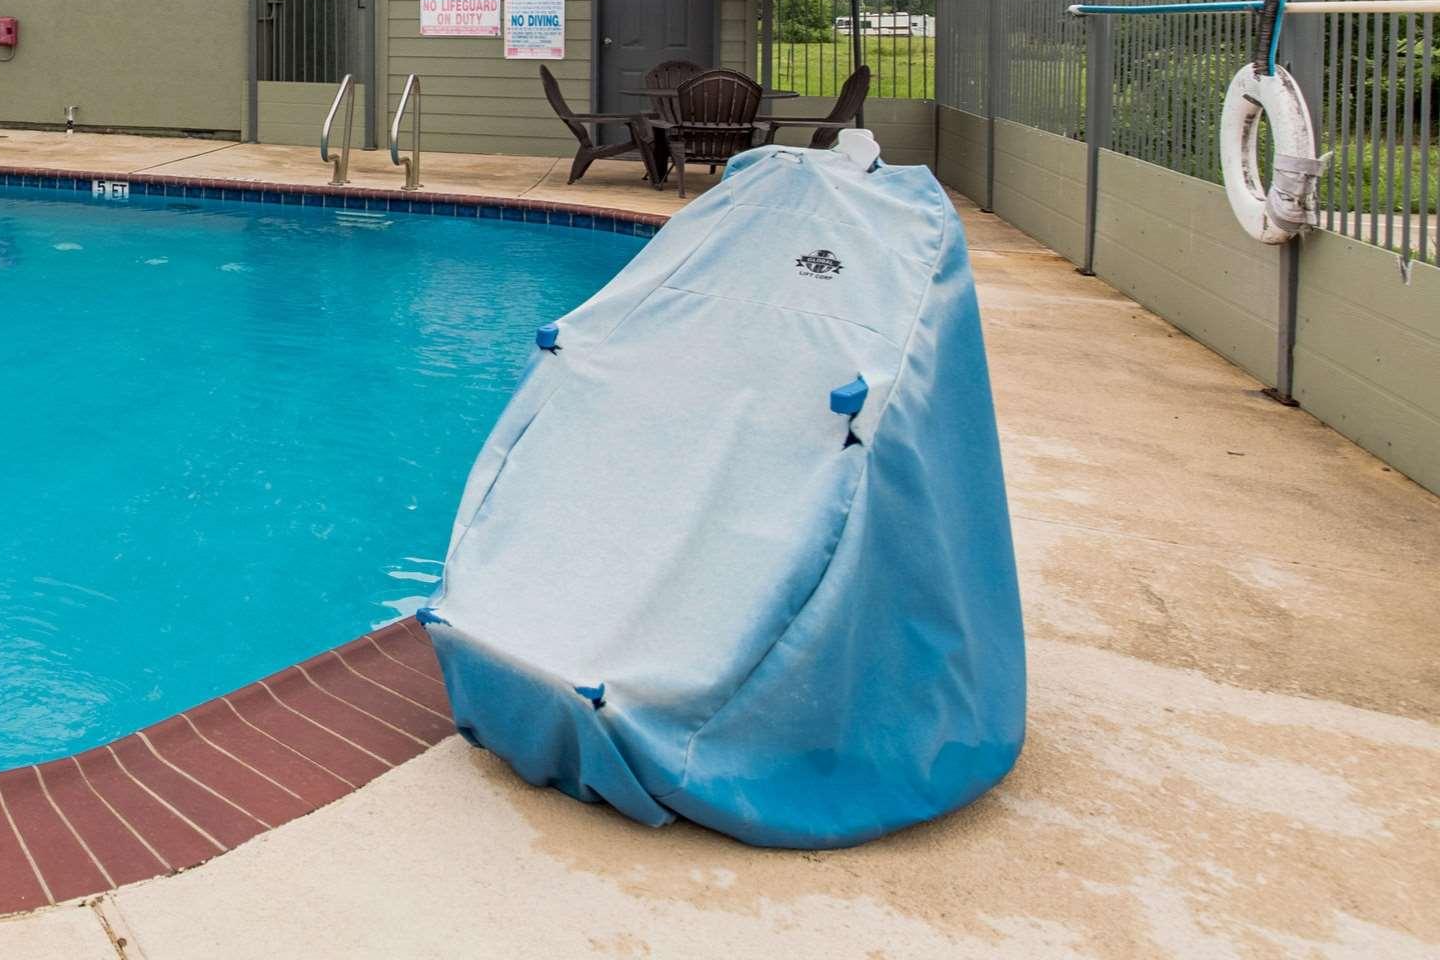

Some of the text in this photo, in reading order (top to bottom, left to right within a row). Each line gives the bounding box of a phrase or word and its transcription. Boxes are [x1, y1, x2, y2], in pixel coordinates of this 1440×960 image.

[423, 0, 437, 11] NO
[442, 0, 498, 11] LIFEGUARD
[437, 13, 482, 25] ON DUTY
[511, 15, 524, 27] NO
[97, 181, 127, 198] 5 FT
